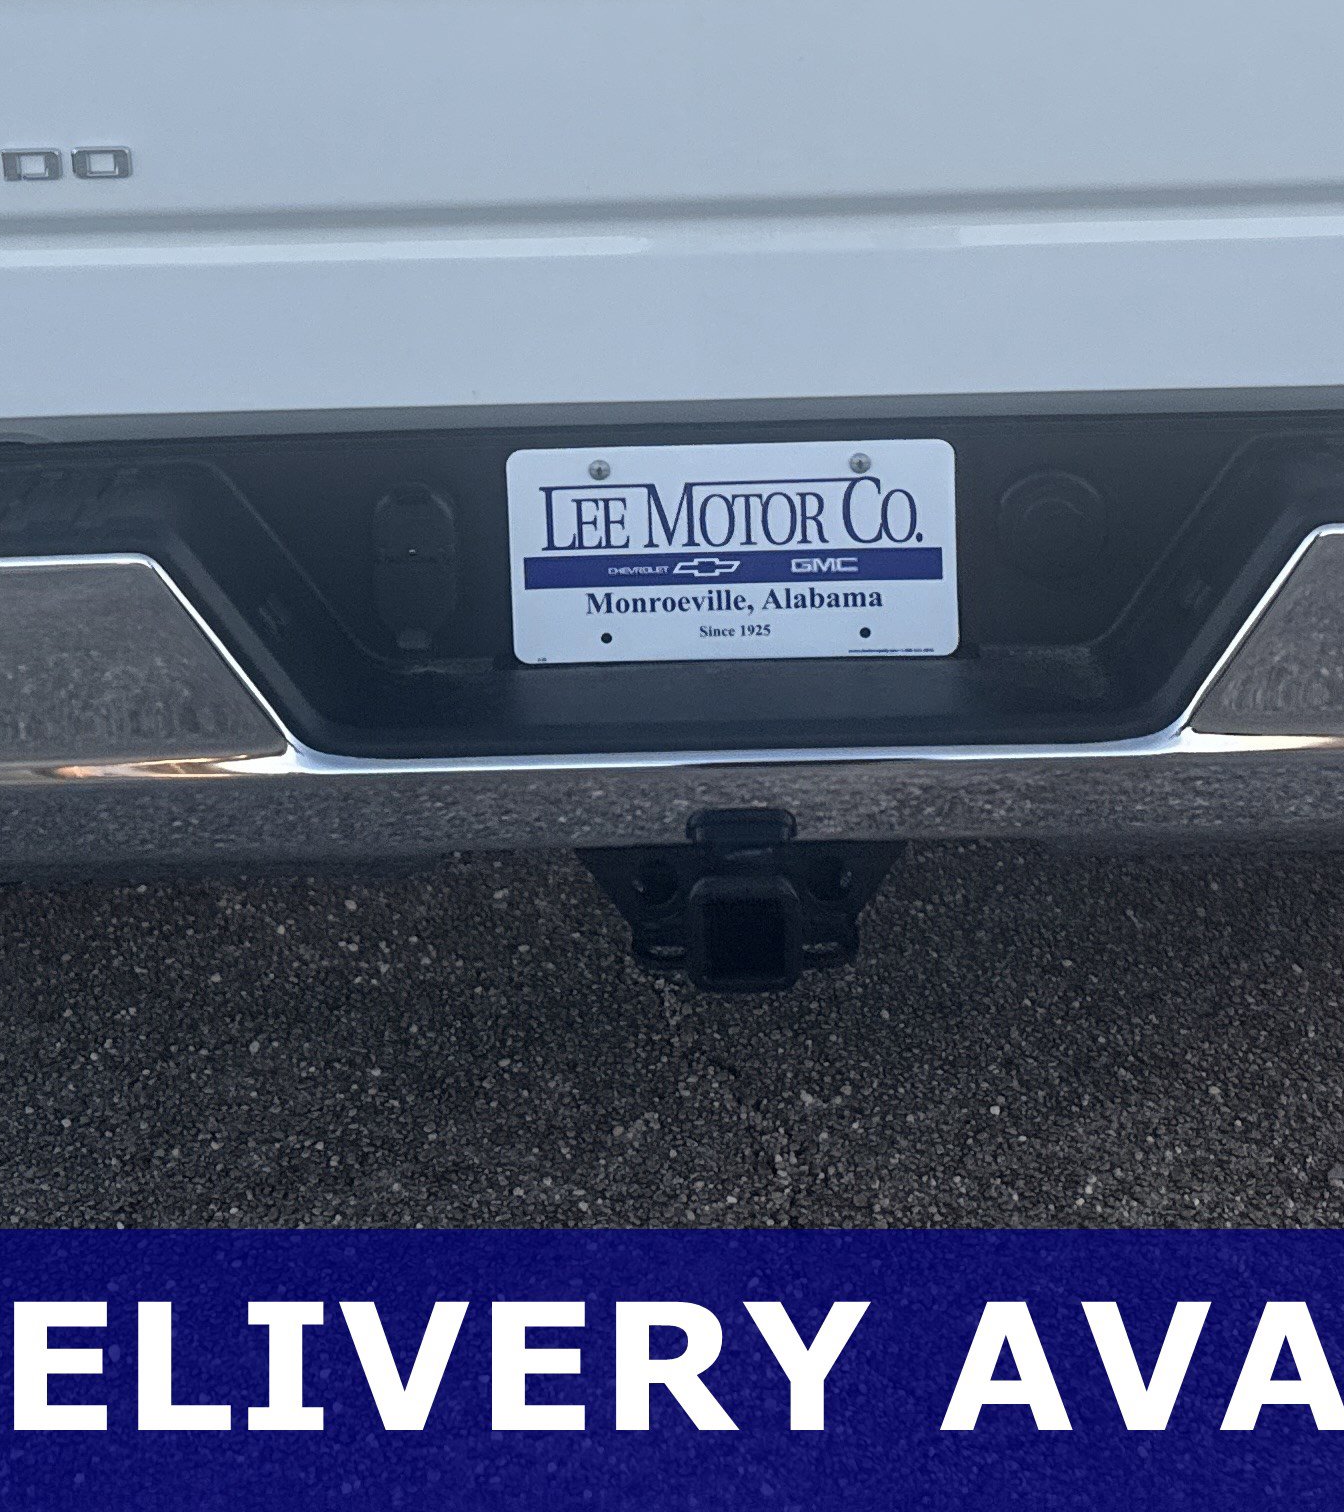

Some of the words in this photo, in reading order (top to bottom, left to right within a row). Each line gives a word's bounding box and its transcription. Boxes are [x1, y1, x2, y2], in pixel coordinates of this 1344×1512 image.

[539, 485, 630, 551] LEE
[644, 479, 830, 549] MOTOR
[842, 475, 923, 544] CO.
[607, 565, 669, 576] CHEVROLET
[790, 557, 859, 574] GMC
[586, 589, 755, 616] Monroeville,
[761, 587, 884, 611] Alabama
[699, 625, 736, 638] Since
[739, 624, 772, 637] 1925
